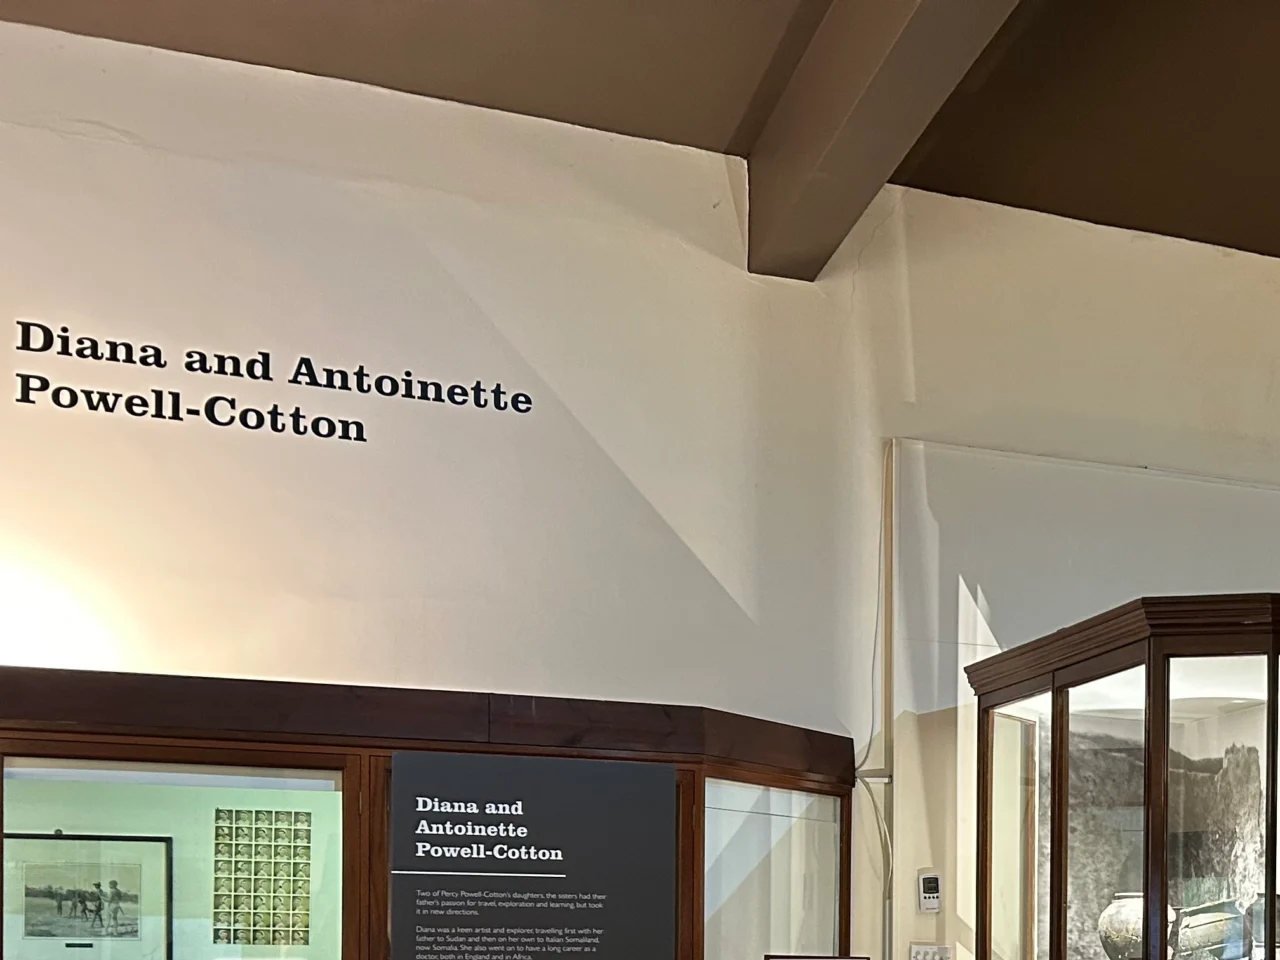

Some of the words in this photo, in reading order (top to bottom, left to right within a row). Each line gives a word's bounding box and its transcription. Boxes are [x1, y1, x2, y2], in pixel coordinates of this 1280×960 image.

[16, 320, 168, 368] Diana
[184, 351, 274, 382] and
[288, 356, 534, 414] Antoinette
[15, 372, 368, 442] Powell-Cotton
[416, 797, 479, 814] Diana
[485, 801, 523, 815] and
[415, 820, 528, 837] Antoinette
[416, 842, 563, 860] Powell-Cotton
[440, 890, 458, 899] Percy
[440, 899, 464, 908] passion
[498, 900, 534, 909] exploration
[535, 927, 562, 936] travelling
[547, 944, 560, 953] long
